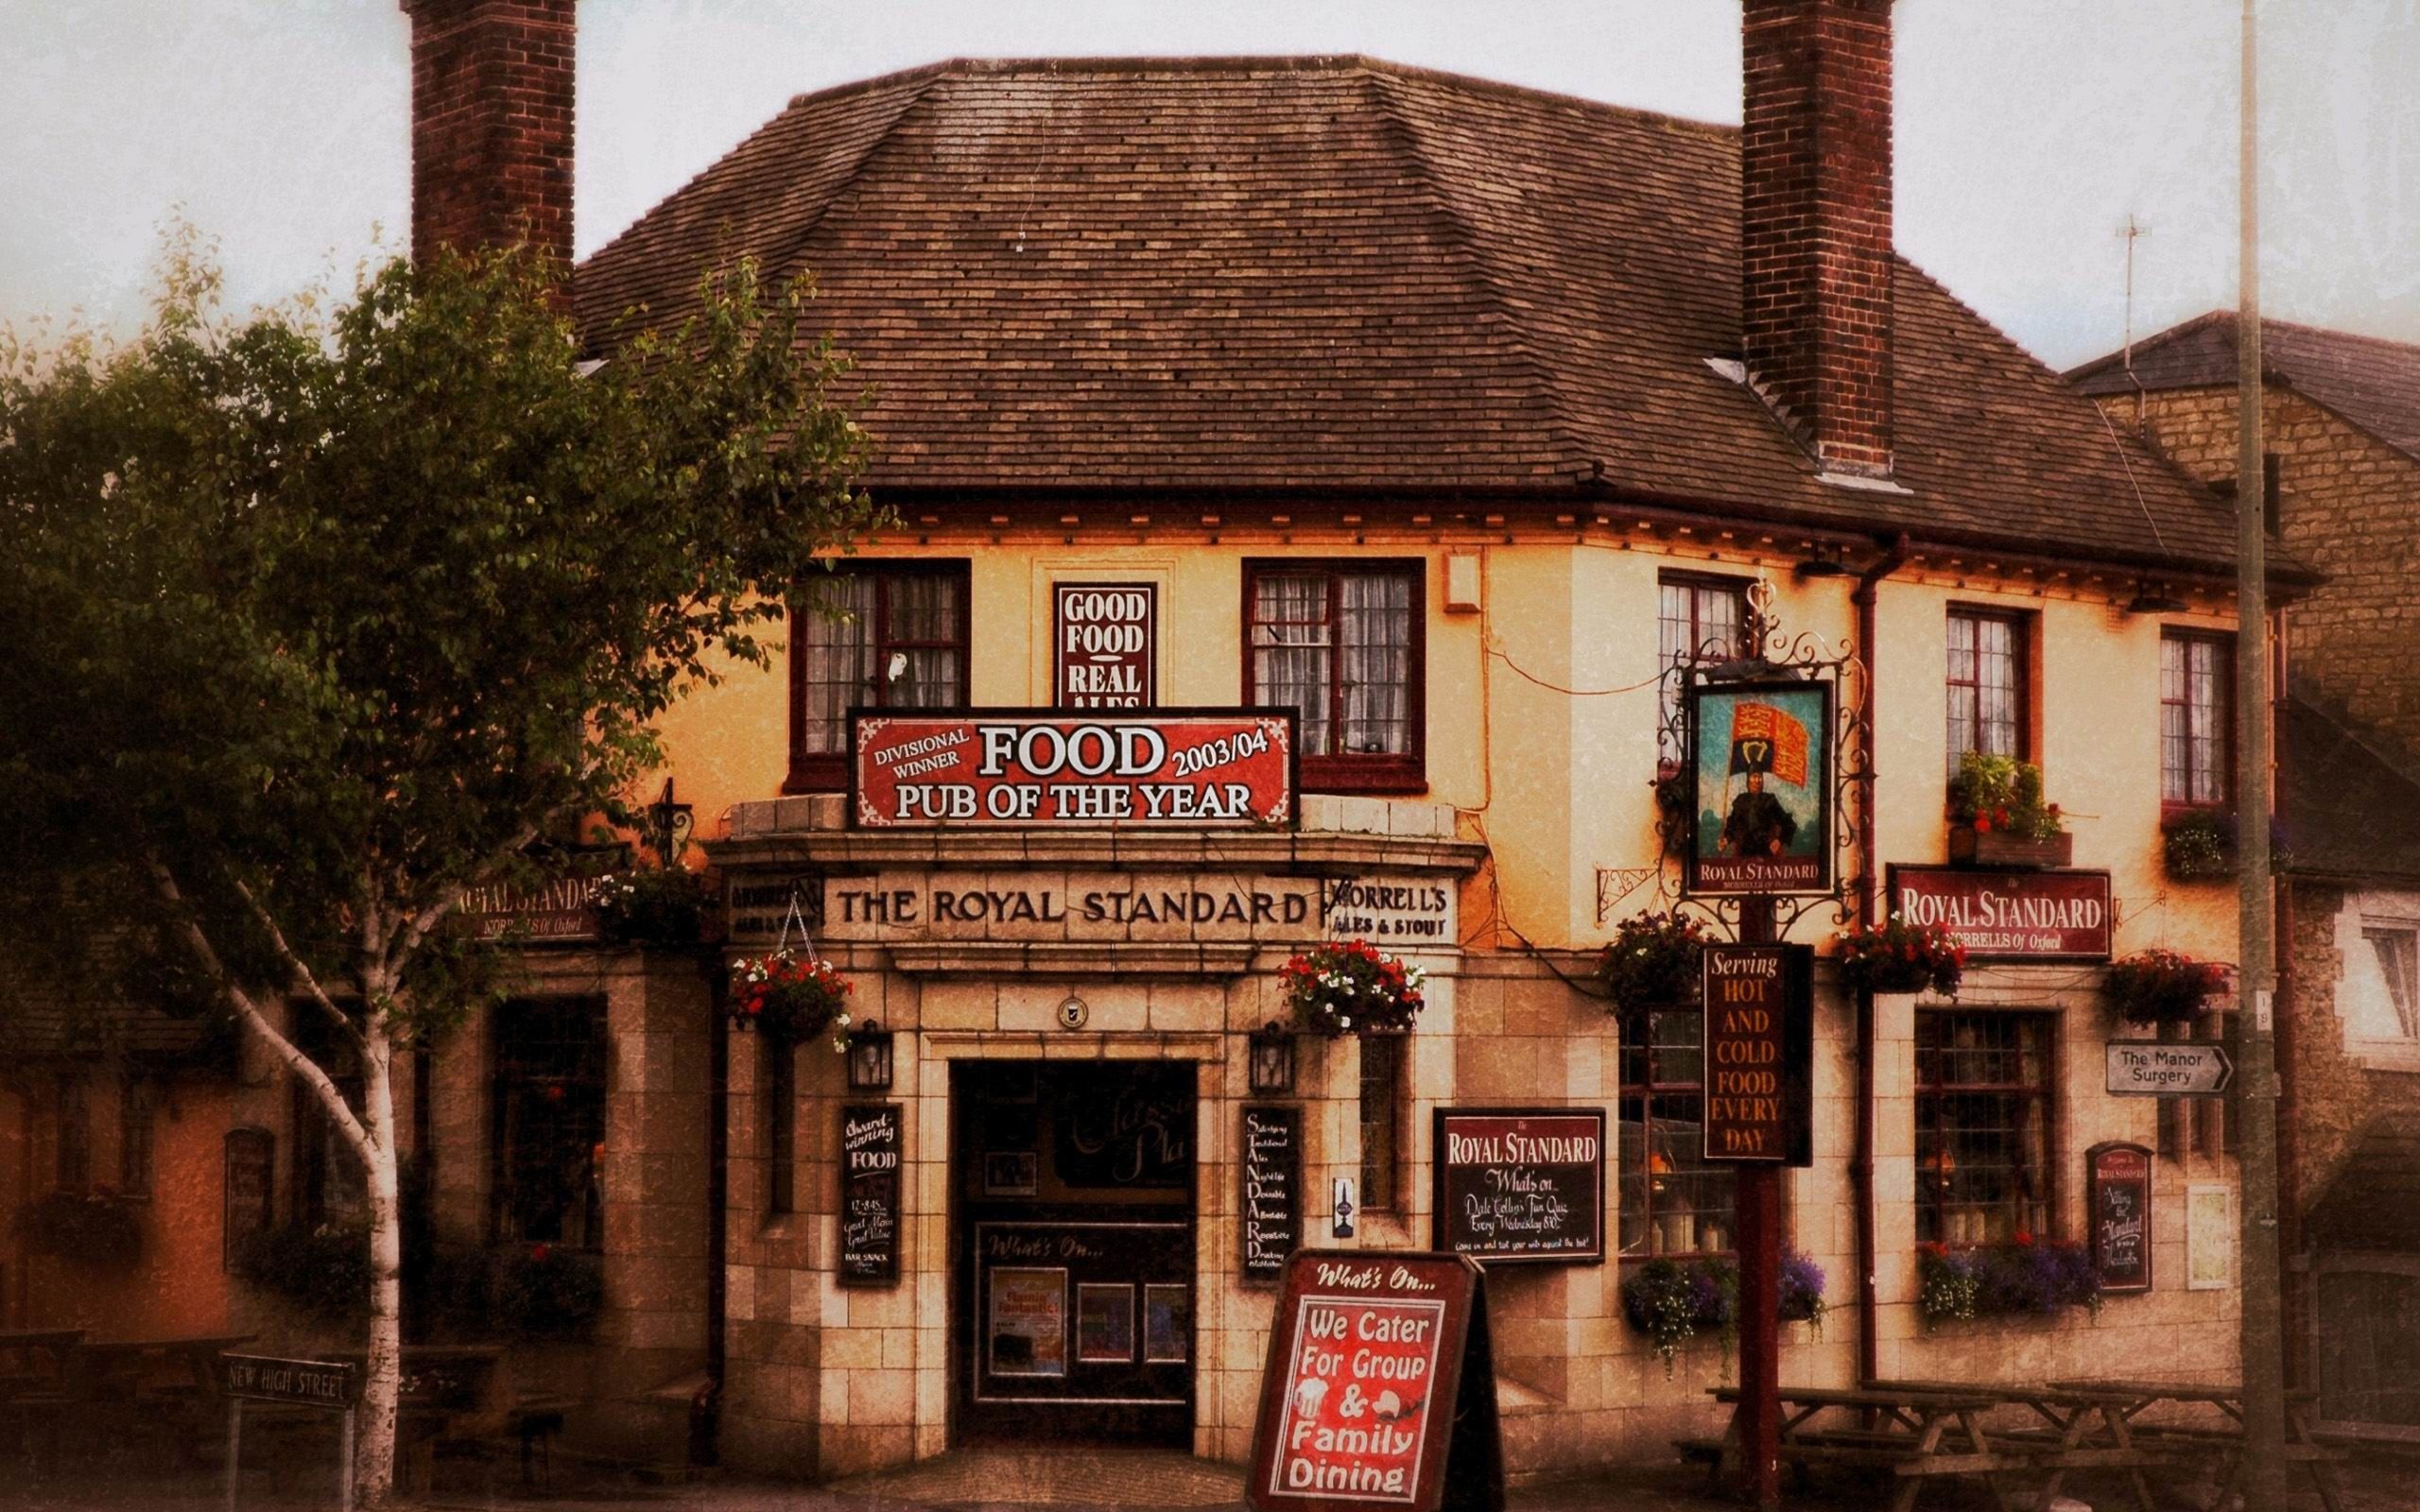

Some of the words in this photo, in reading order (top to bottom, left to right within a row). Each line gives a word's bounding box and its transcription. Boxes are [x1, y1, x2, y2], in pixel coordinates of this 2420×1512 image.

[1064, 593, 1146, 622] GOOD
[1066, 625, 1144, 653] FOOD
[1068, 665, 1142, 693] REAL
[873, 729, 970, 766] DIVISIONAL
[979, 726, 1166, 776] FOOD
[1171, 728, 1268, 778] 2003/04
[892, 751, 960, 780] WINNER
[895, 784, 977, 818] PUB
[987, 784, 1041, 818] OF
[1049, 784, 1132, 818] THE
[1138, 784, 1253, 818] YEAR
[1701, 864, 1744, 881] ROYAL
[1746, 863, 1819, 881] STANDARD
[837, 890, 918, 922] THE
[934, 890, 1066, 924] ROYAL
[1083, 890, 1307, 924] STANDARD
[1902, 887, 1977, 927] ROYAL
[1979, 890, 2101, 930] STANDARD
[1378, 919, 1390, 935] &
[1394, 919, 1446, 936] STOUT
[2030, 934, 2062, 951] Oxford
[1711, 951, 1777, 978] Serving
[1723, 979, 1767, 1002] HOT
[1722, 1010, 1770, 1033] AND
[1716, 1040, 1776, 1064] COLD
[2120, 1051, 2149, 1066] The
[2155, 1051, 2204, 1066] Manor
[1718, 1071, 1776, 1094] FOOD
[2133, 1067, 2191, 1085] Surgery
[1711, 1098, 1780, 1122] EVERY
[845, 1127, 894, 1150] winning
[1448, 1133, 1503, 1164] ROYAL
[1505, 1132, 1597, 1164] STANDARD
[1723, 1128, 1767, 1152] DAY
[852, 1151, 897, 1168] FOOD
[1484, 1165, 1538, 1193] What's
[1469, 1213, 1495, 1237] Every
[1495, 1213, 1542, 1233] Wednesday
[988, 1234, 1051, 1257] What's
[1483, 1240, 1496, 1249] and
[1316, 1263, 1381, 1289] What's
[1310, 1309, 1348, 1340] We
[1357, 1311, 1429, 1343] Cater
[1300, 1346, 1343, 1377] For
[1352, 1349, 1426, 1381] Group
[228, 1366, 257, 1389] NEW
[261, 1368, 292, 1393] HIGH
[297, 1371, 345, 1399] STREET
[1339, 1383, 1369, 1418] &
[1291, 1420, 1414, 1455] Family
[1288, 1457, 1405, 1493] Dining
